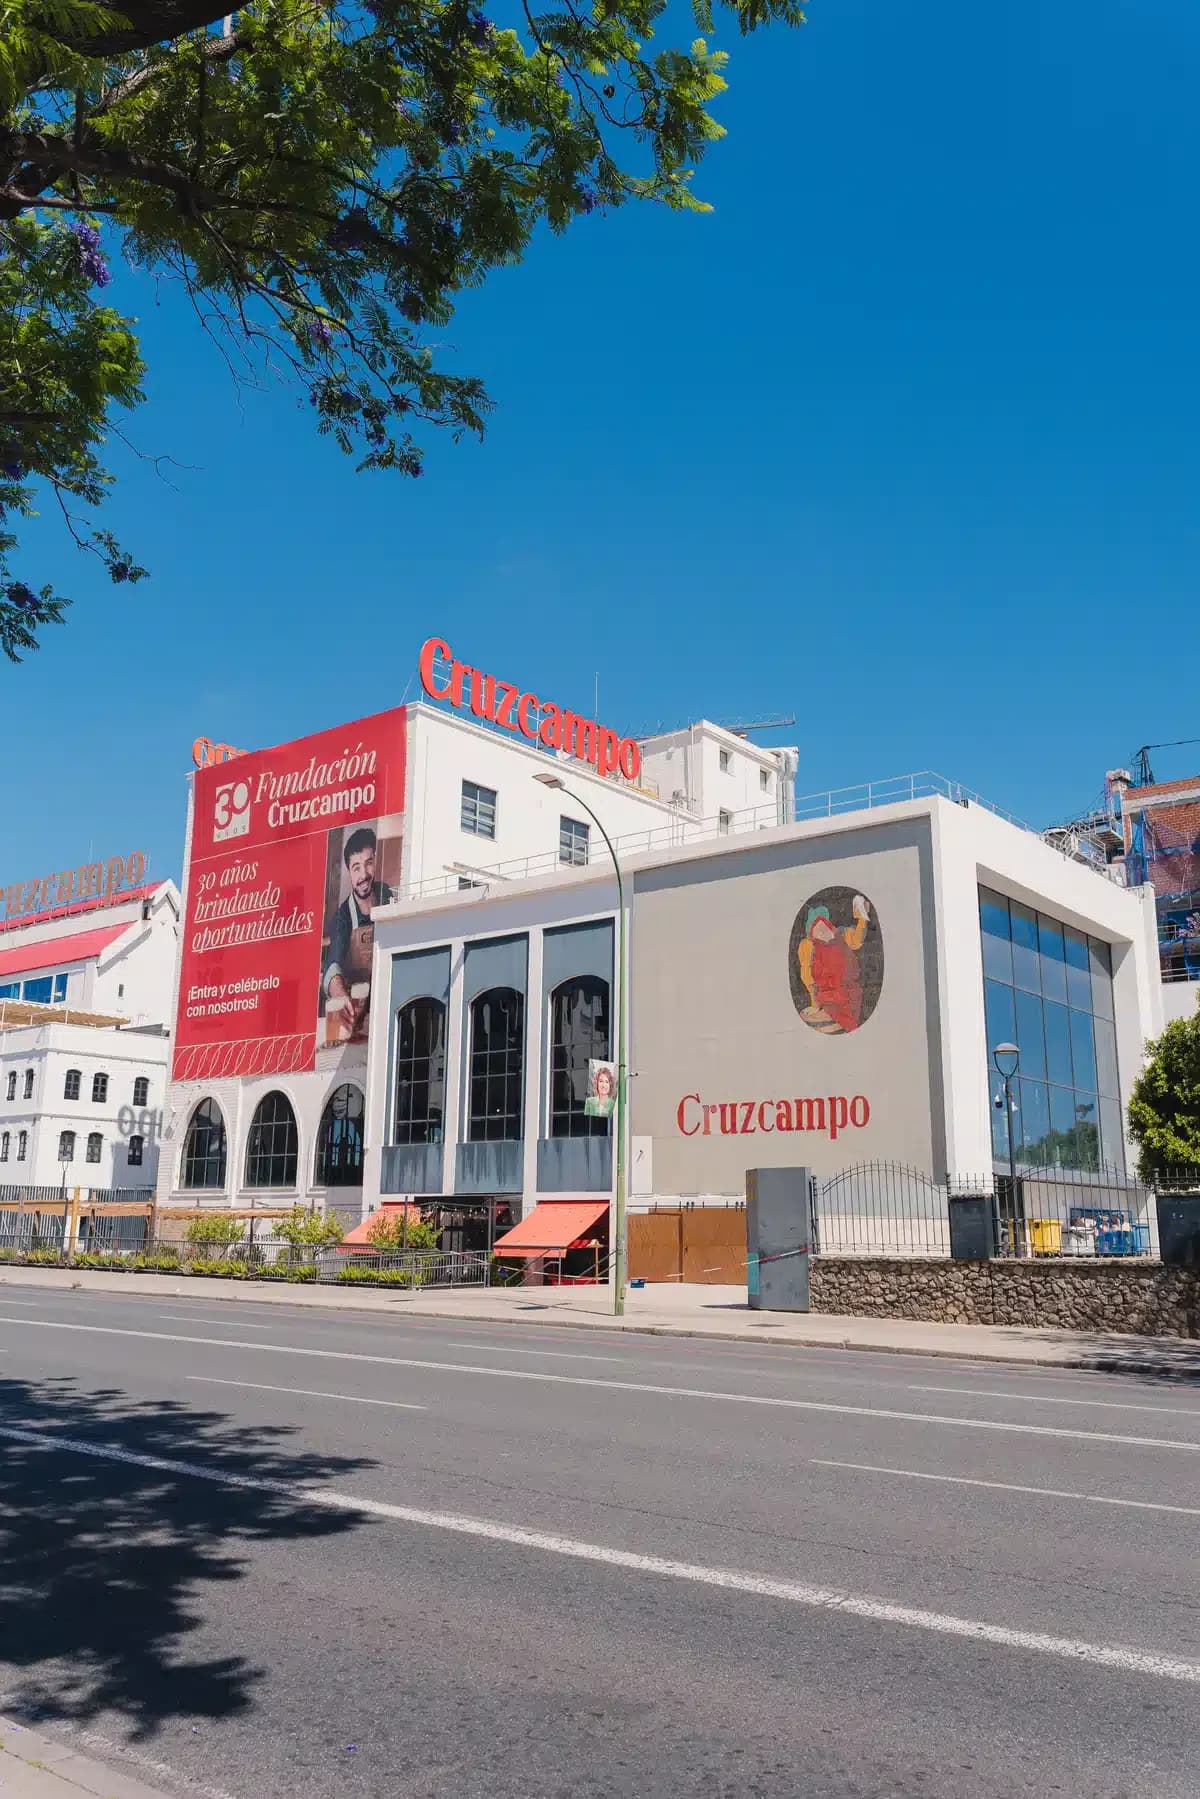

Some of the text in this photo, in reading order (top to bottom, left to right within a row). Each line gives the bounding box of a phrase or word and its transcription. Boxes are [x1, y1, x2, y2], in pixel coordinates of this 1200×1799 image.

[419, 637, 641, 780] Cruzcampo
[254, 742, 377, 804] Fundación
[267, 784, 376, 828] Cruzcampo
[0, 850, 145, 914] uzcampo
[195, 859, 260, 897] 30 años
[194, 881, 281, 921] brindando
[191, 906, 314, 953] oportunidades
[186, 994, 259, 1018] con nosotros!
[187, 974, 280, 1004] ¡Entra y celébralo
[676, 1093, 871, 1140] Cruzcampo
